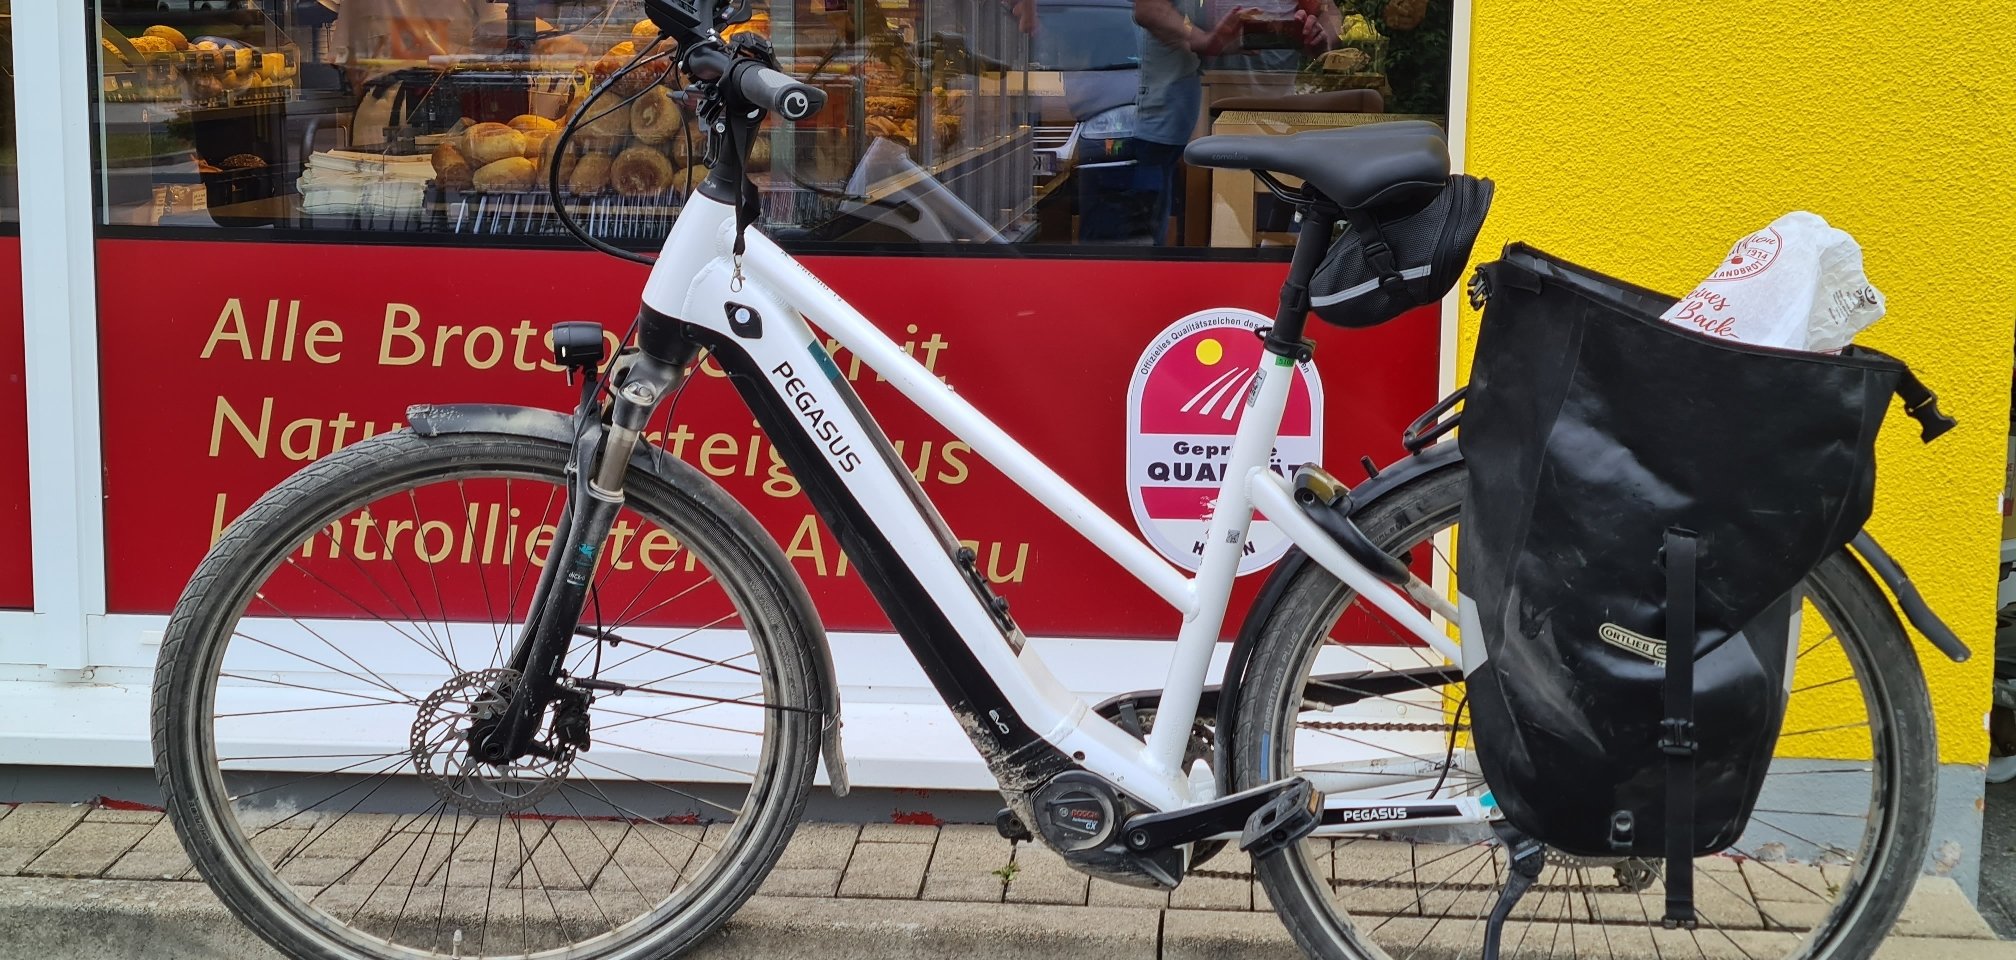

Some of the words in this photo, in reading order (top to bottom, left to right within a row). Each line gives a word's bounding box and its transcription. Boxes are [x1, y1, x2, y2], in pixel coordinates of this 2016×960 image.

[200, 298, 344, 365] Alle
[1140, 339, 1172, 375] Offizielles
[1170, 315, 1241, 341] Qualitätszeichen
[1674, 300, 1740, 339] Back
[772, 360, 862, 473] PEGASUS
[1605, 628, 1650, 652] ORTLIEB
[1263, 666, 1284, 732] MARATHON
[1282, 631, 1300, 663] PLUS
[1343, 807, 1408, 823] PEGASUS
